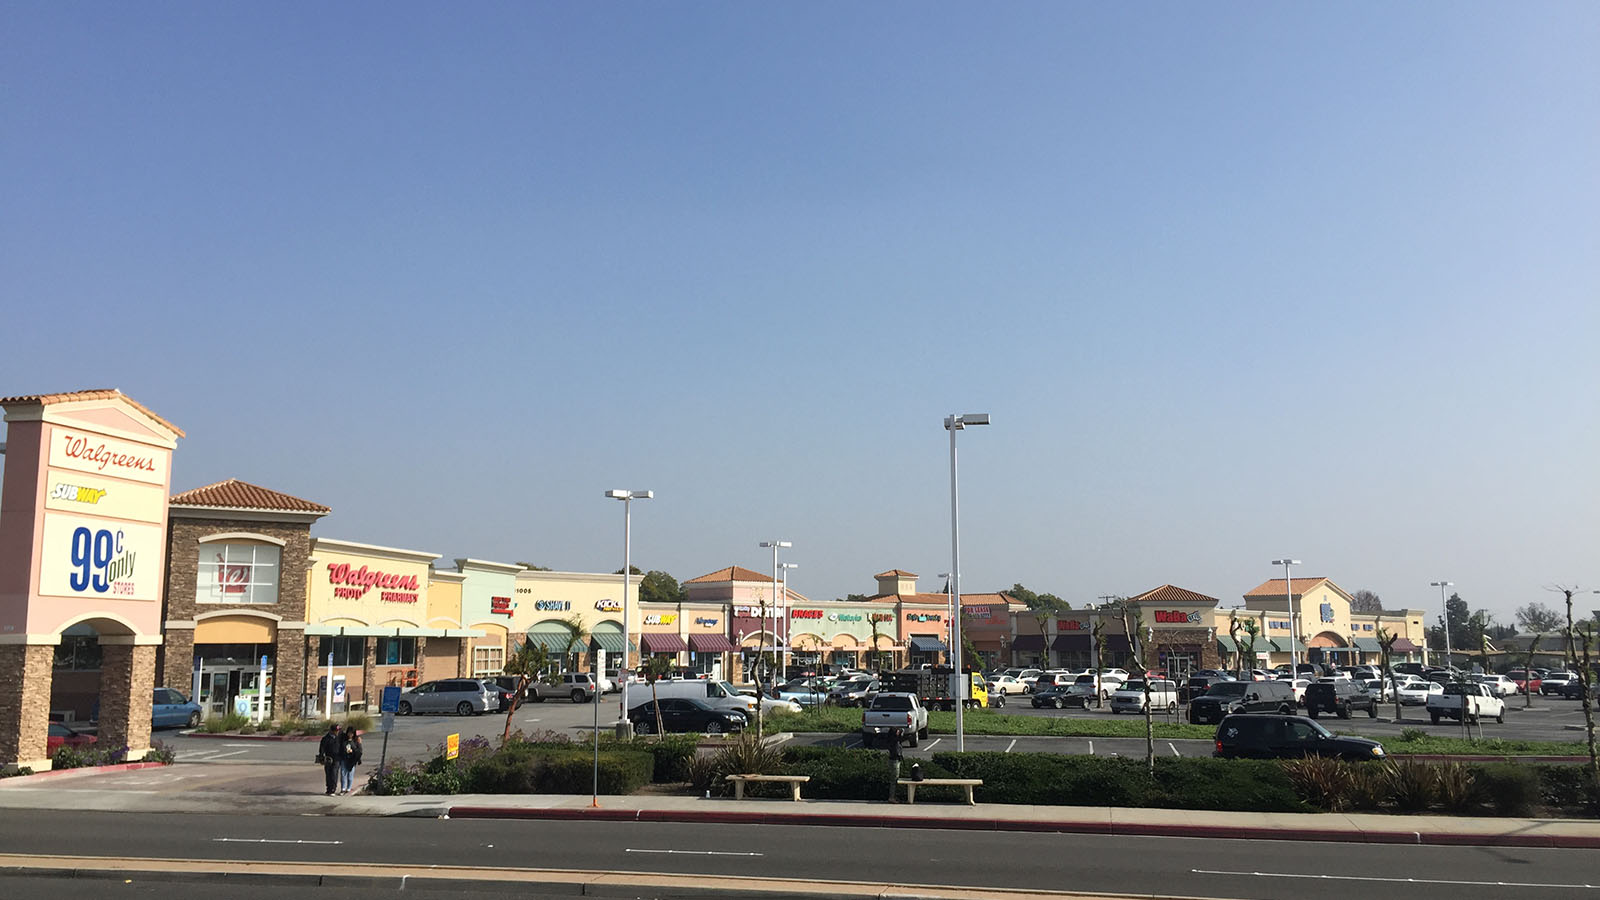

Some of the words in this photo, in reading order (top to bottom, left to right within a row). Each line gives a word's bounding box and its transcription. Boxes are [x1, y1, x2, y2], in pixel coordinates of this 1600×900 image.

[64, 435, 155, 471] Walgreens
[50, 483, 107, 504] SUBWAY
[109, 550, 136, 582] only
[327, 563, 419, 594] Walgreens
[334, 587, 362, 600] PHOTO
[381, 591, 418, 603] PHARMACY
[644, 614, 678, 625] SUBWAY
[1155, 610, 1187, 623] WaBa
